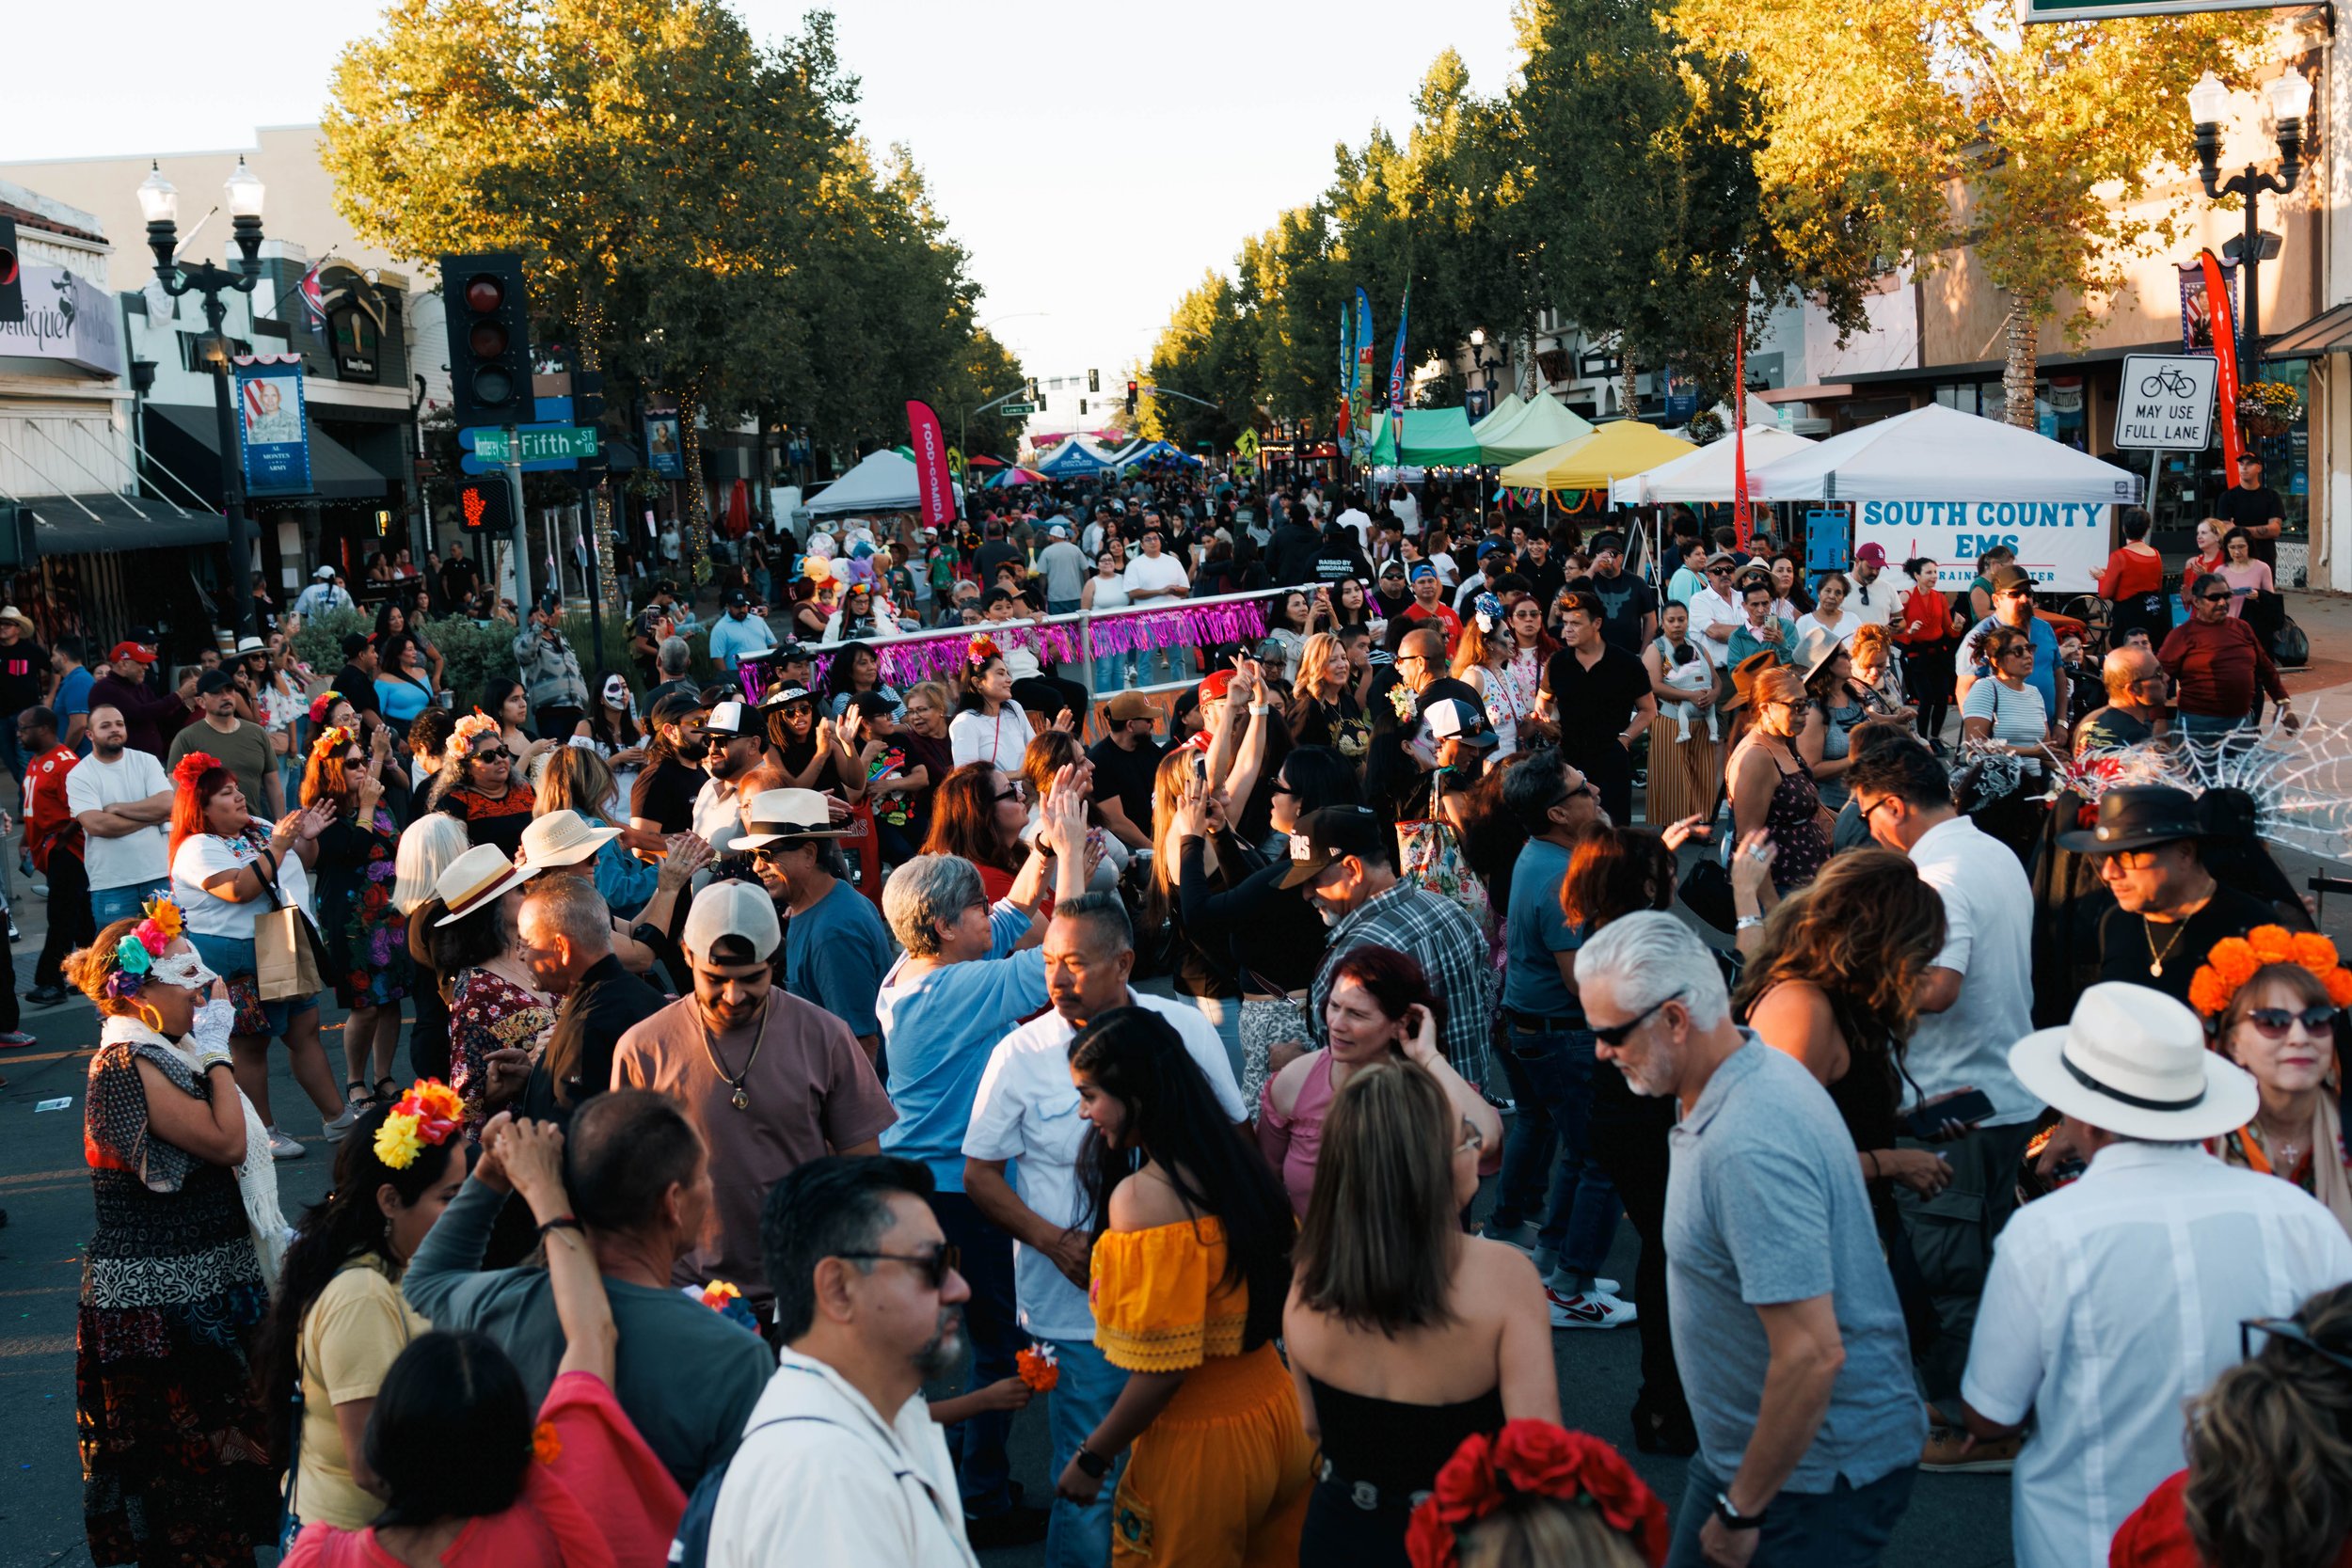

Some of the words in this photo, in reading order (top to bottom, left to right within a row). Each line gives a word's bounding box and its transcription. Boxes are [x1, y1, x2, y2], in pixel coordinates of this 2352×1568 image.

[2136, 404, 2162, 418] MAY
[2169, 405, 2194, 419] USE
[520, 434, 570, 455] Fifth
[581, 430, 593, 441] ST
[2124, 424, 2157, 438] FULL
[2165, 425, 2200, 439] LANE
[584, 442, 595, 453] 10
[922, 422, 935, 460] FOOD
[930, 467, 944, 522] COMIDA
[1864, 501, 1967, 526] SOUTH
[1977, 501, 2104, 527] COUNTY
[1955, 534, 2019, 558] EMS
